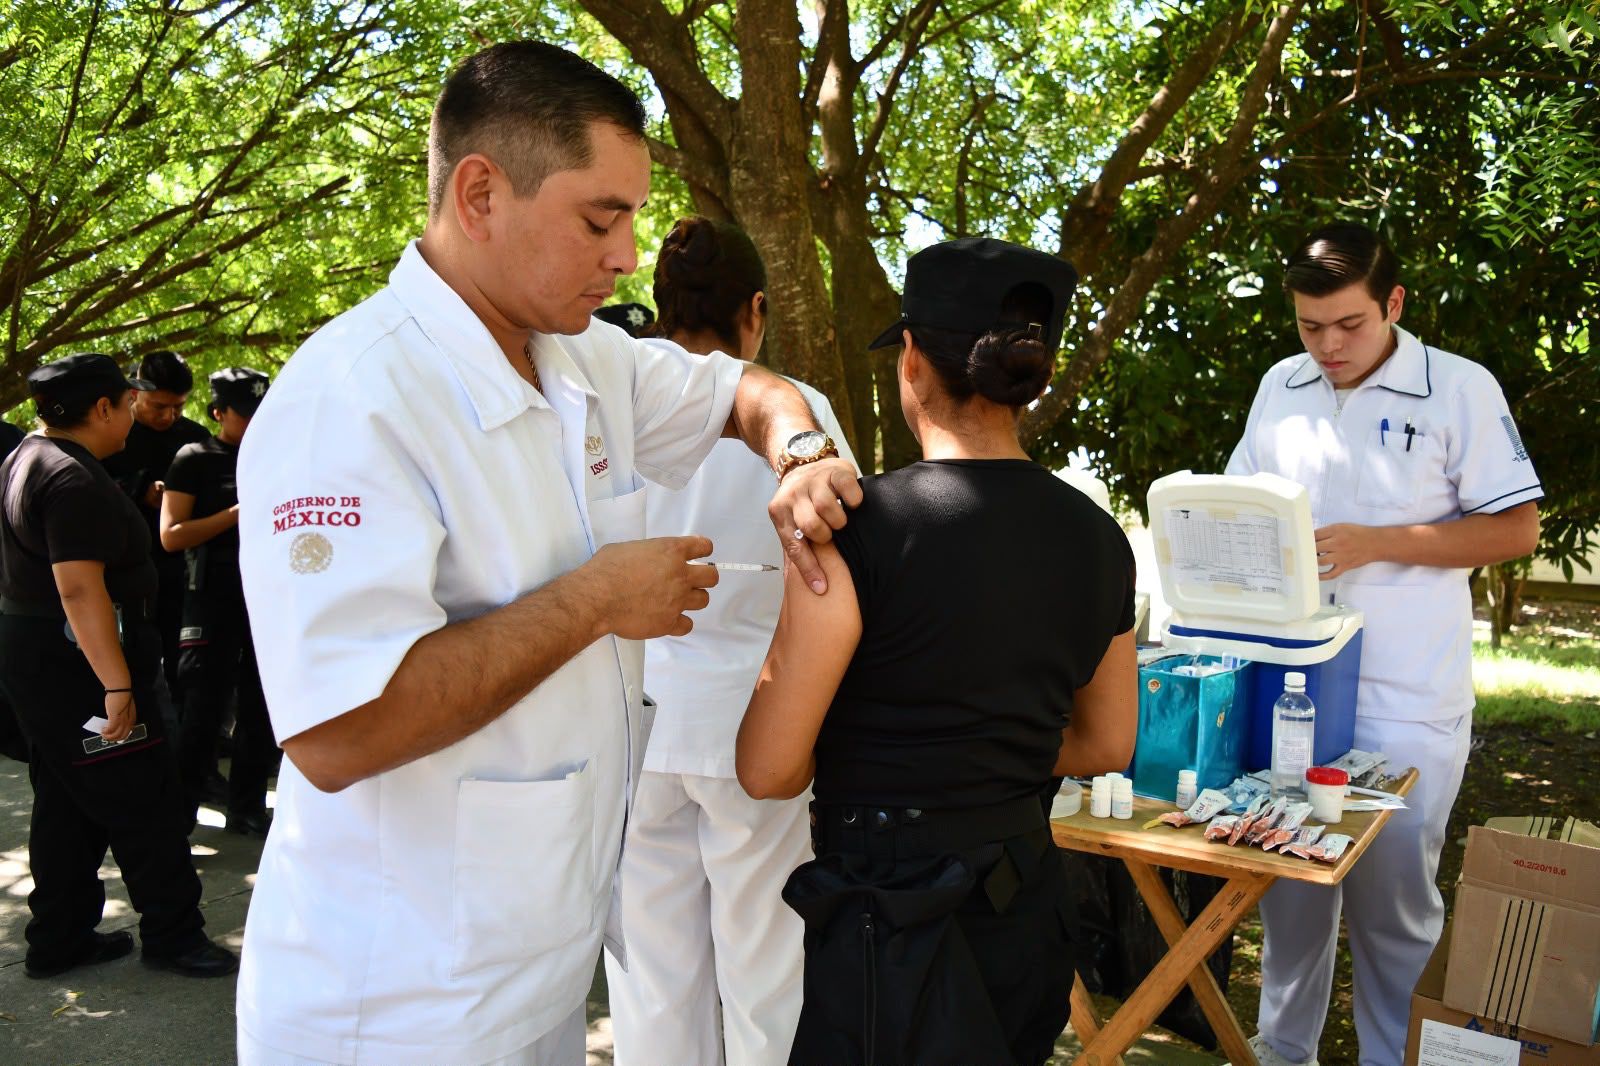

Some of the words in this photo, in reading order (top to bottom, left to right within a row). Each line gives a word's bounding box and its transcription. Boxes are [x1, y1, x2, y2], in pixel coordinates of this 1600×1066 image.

[273, 496, 336, 516] GOBIERNO
[340, 496, 361, 508] DE
[273, 510, 361, 535] MÉXICO
[1513, 858, 1567, 876] 40.2/20/18.6
